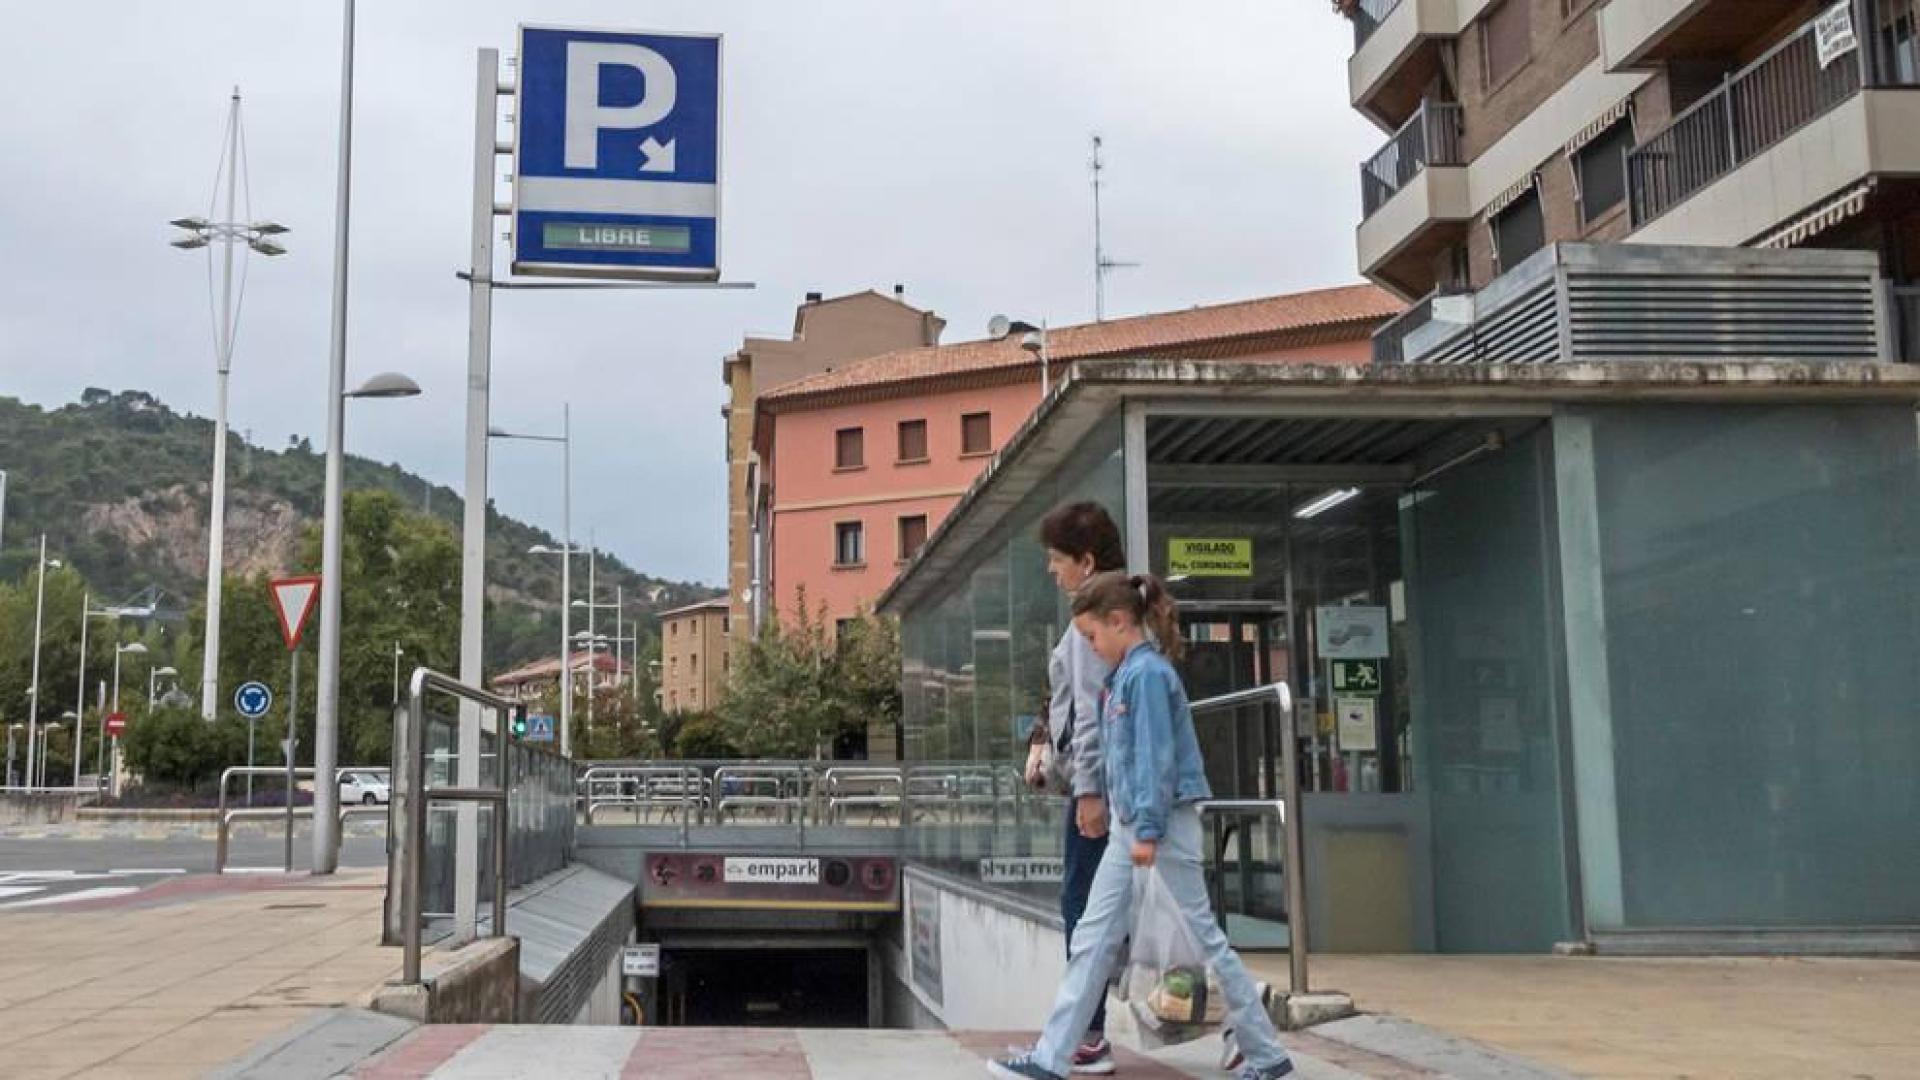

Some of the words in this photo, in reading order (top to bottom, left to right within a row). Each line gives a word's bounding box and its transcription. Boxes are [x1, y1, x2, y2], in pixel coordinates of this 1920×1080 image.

[563, 40, 677, 169] P
[578, 227, 651, 246] LIBRE
[1185, 542, 1236, 553] VIGILADO
[747, 859, 818, 879] empark
